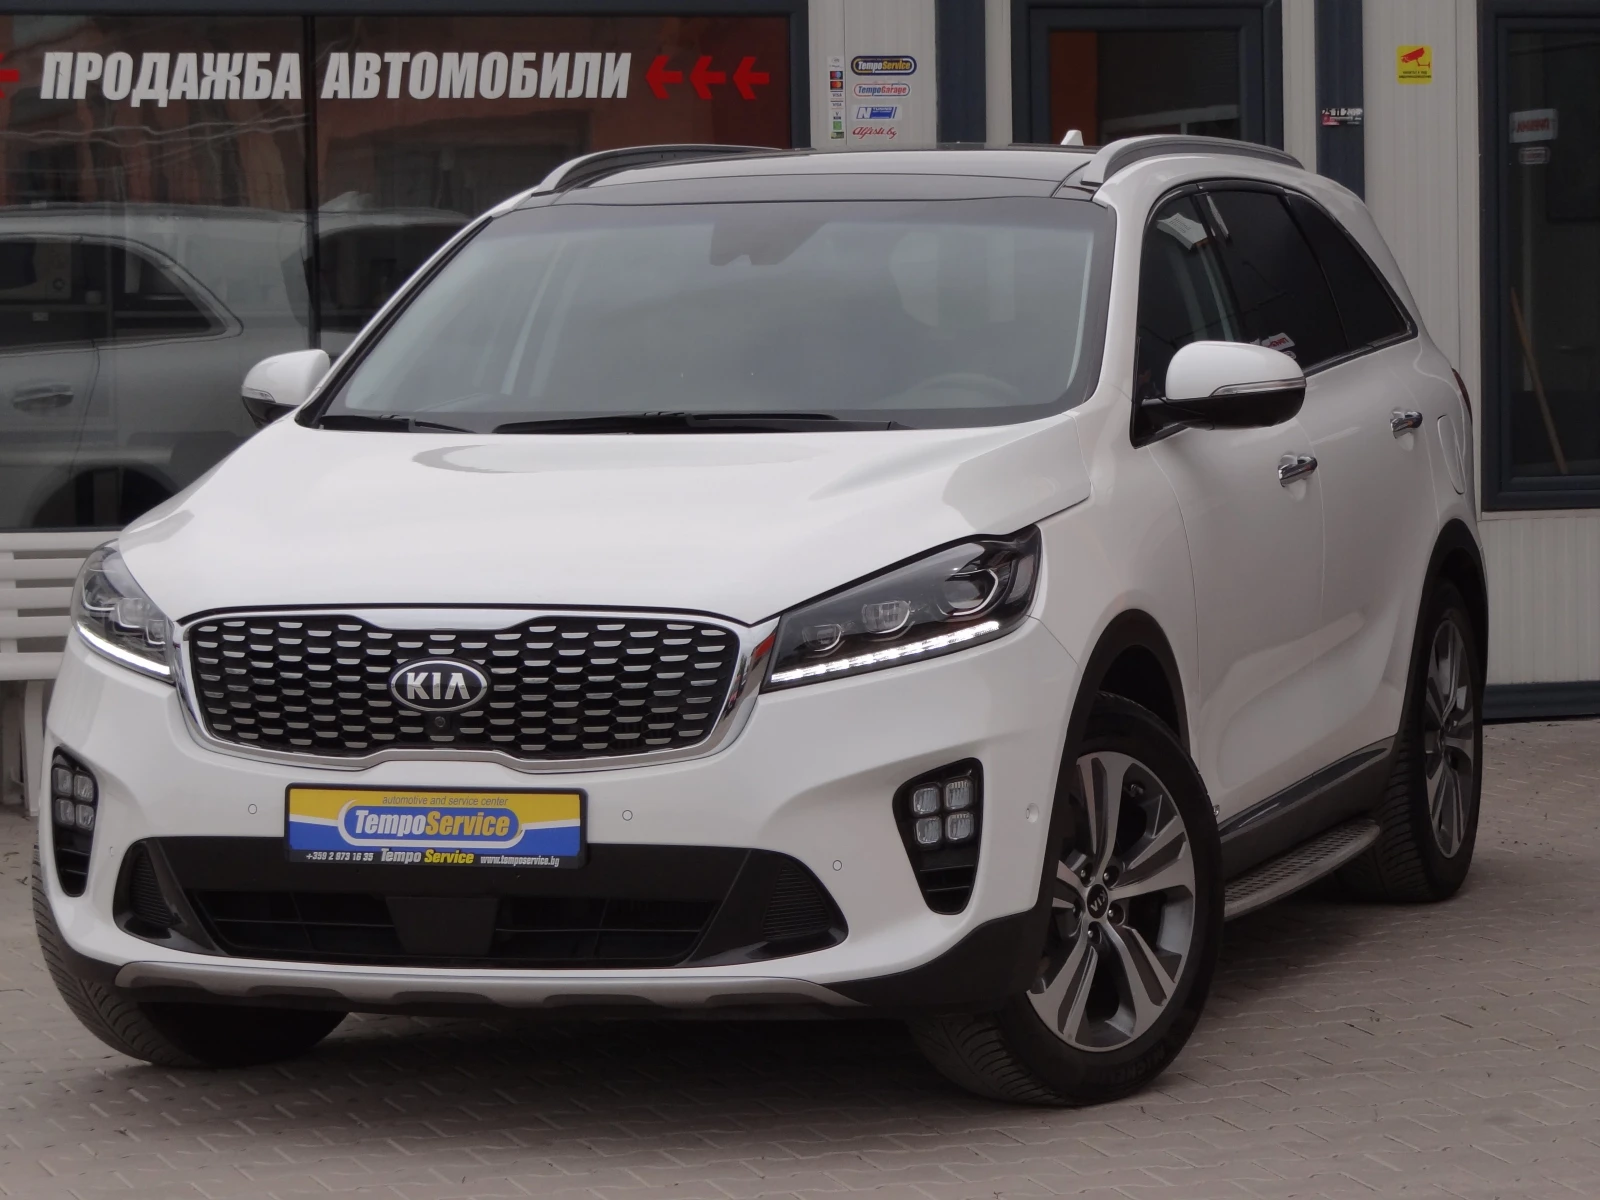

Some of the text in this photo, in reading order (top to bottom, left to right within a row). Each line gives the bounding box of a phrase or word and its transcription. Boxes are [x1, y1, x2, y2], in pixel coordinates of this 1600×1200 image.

[858, 61, 910, 73] TempoService
[40, 51, 632, 108] ПРОДАЖБА АВТОМОБИЛИ
[858, 86, 907, 96] TempoGarage
[406, 672, 471, 700] KIA
[382, 795, 509, 807] automotive and service center
[355, 810, 510, 837] TempoService
[305, 851, 328, 861] +359
[328, 852, 335, 861] 2
[352, 852, 362, 862] 16
[362, 852, 375, 862] 35
[381, 847, 422, 865] Tempo
[424, 848, 475, 864] Service
[480, 855, 560, 867] www.temposervice.bg
